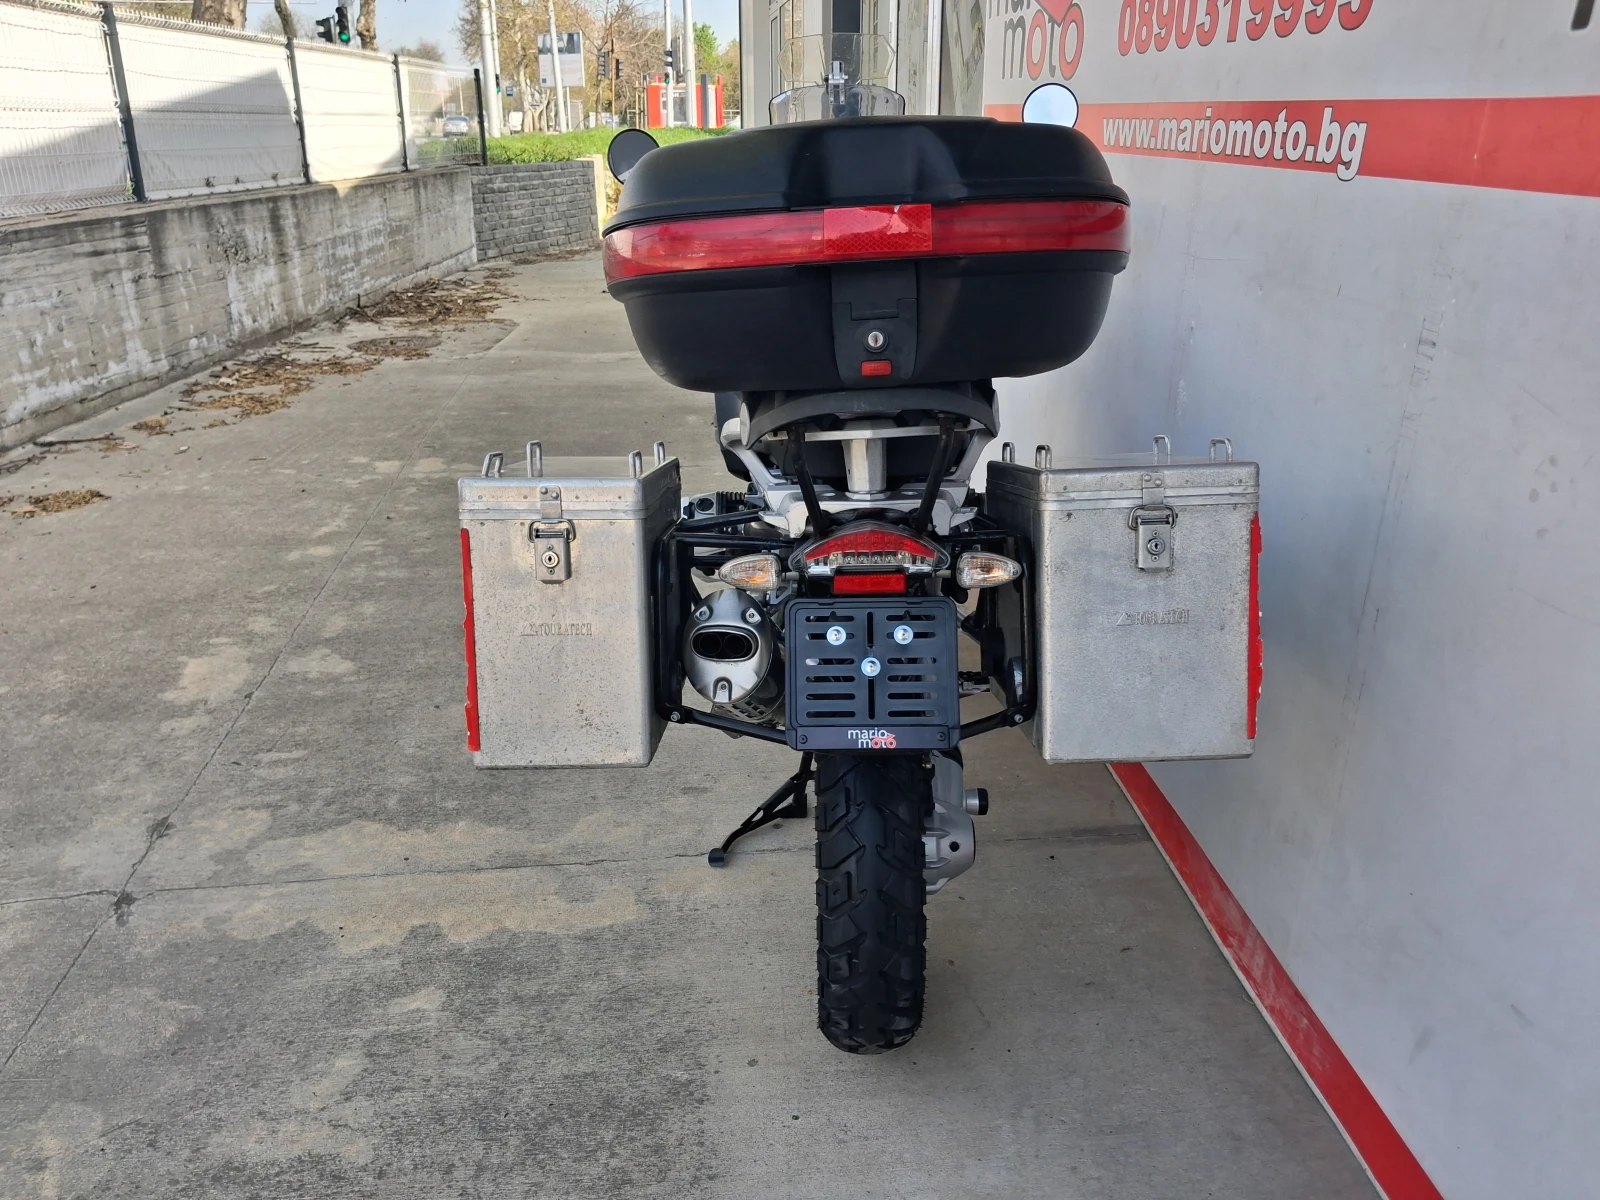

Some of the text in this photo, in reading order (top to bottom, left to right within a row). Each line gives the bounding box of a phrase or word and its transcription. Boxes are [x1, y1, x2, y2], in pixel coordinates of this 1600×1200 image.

[1002, 2, 1085, 81] moto
[1103, 106, 1368, 181] www.mariomoto.bg
[540, 622, 593, 637] TOURATECH
[847, 727, 888, 739] mario
[858, 738, 897, 749] moto
